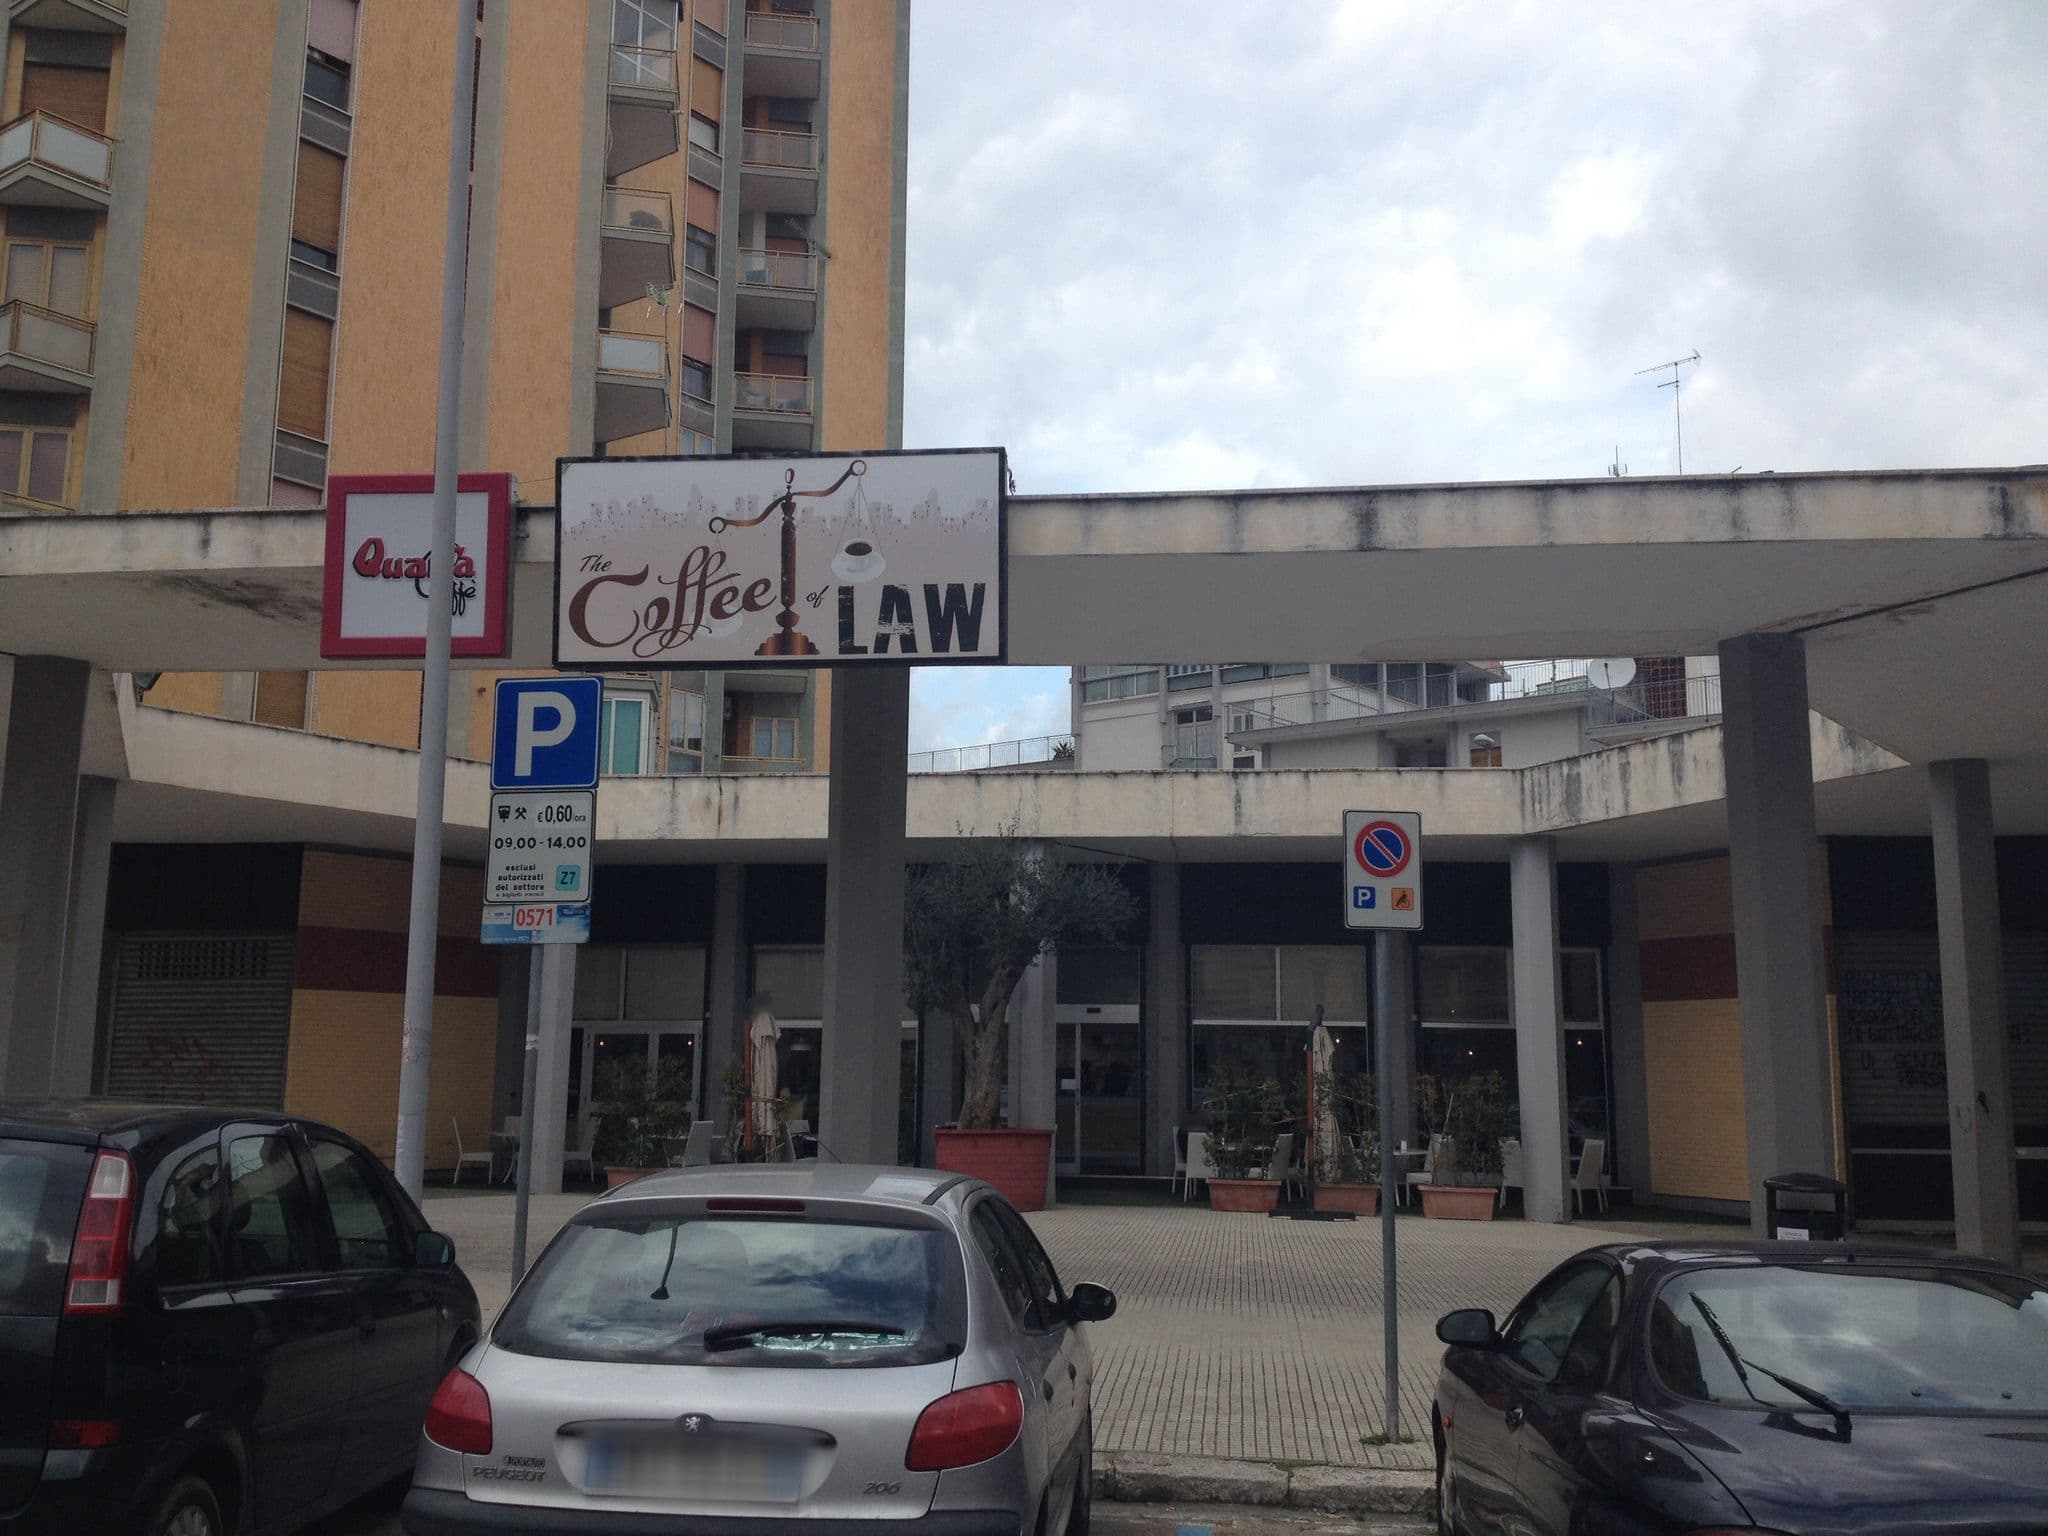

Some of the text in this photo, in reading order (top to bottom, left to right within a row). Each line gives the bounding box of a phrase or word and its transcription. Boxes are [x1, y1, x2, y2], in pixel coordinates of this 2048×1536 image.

[352, 535, 476, 579] Quaa
[580, 554, 612, 572] The
[568, 545, 987, 658] Coffee of LAW
[514, 690, 577, 777] P
[505, 864, 536, 872] esclusi
[497, 873, 544, 881] autorizzati
[560, 871, 577, 885] Z7
[513, 883, 545, 891] settore
[1358, 888, 1371, 906] P
[515, 907, 554, 927] 0571
[472, 1465, 546, 1482] PEUGEOT
[863, 1480, 902, 1496] 206
